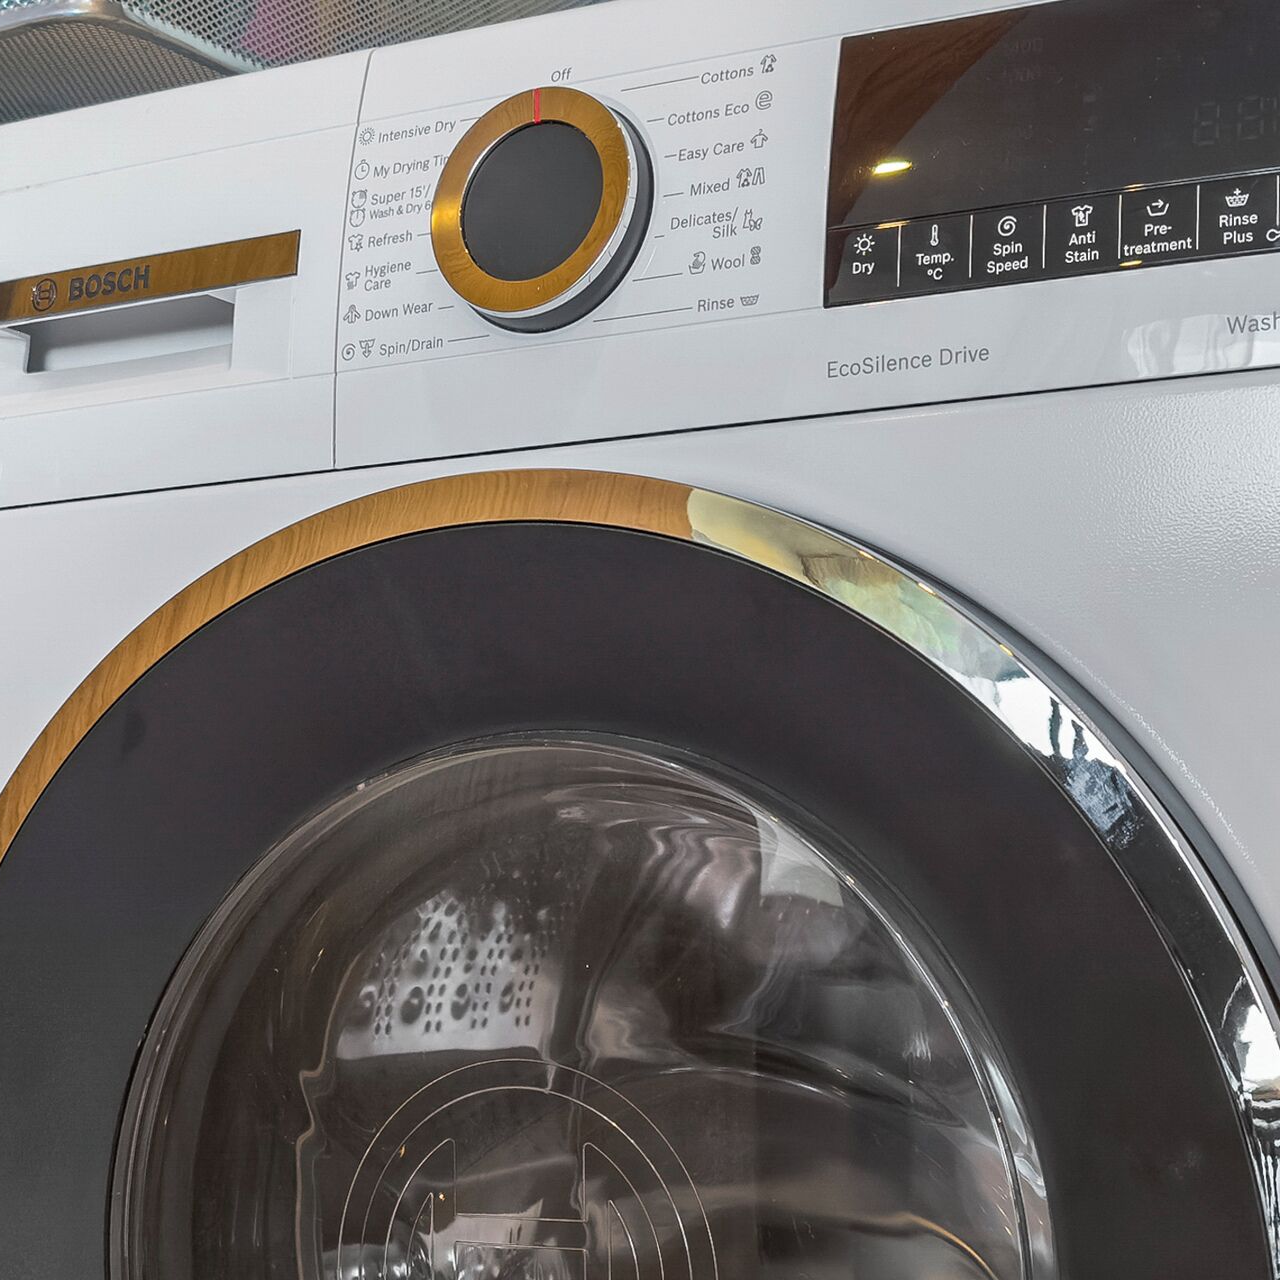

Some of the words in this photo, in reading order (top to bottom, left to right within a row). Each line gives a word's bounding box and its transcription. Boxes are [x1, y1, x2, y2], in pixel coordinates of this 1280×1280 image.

[551, 67, 572, 82] Off
[700, 66, 754, 85] Cottons
[667, 108, 720, 126] Cottons
[724, 103, 750, 117] Eco
[378, 125, 431, 143] Intensive
[435, 120, 456, 133] Dry
[678, 147, 709, 162] Easy
[713, 141, 745, 156] Care
[373, 165, 390, 179] My
[392, 158, 430, 174] Drying
[370, 190, 406, 206] Super
[410, 184, 431, 199] 15'/
[690, 178, 730, 197] Mixed
[369, 207, 395, 220] Wash
[396, 204, 404, 215] &
[405, 202, 424, 216] Dry
[670, 206, 739, 230] Delicates/
[1219, 213, 1258, 228] Rinse
[367, 230, 413, 248] Refresh
[712, 223, 737, 239] Silk
[1068, 231, 1096, 247] Anti
[1144, 223, 1173, 237] Pre-
[1223, 230, 1254, 245] Plus
[993, 241, 1023, 258] Spin
[1064, 248, 1099, 264] Stain
[1123, 237, 1193, 257] treatment
[711, 254, 745, 271] Wool
[852, 261, 875, 276] Dry
[915, 252, 955, 267] Temp.
[986, 256, 1029, 275] Speed
[365, 261, 412, 279] Hygiene
[927, 268, 943, 281] °C
[68, 264, 150, 302] BOSCH
[364, 279, 392, 292] Care
[365, 308, 399, 322] Down
[402, 302, 434, 316] Wear
[697, 298, 735, 313] Rinse
[379, 336, 444, 358] Spin/Drain
[827, 354, 932, 379] EcoSilence
[939, 346, 990, 366] Drive
